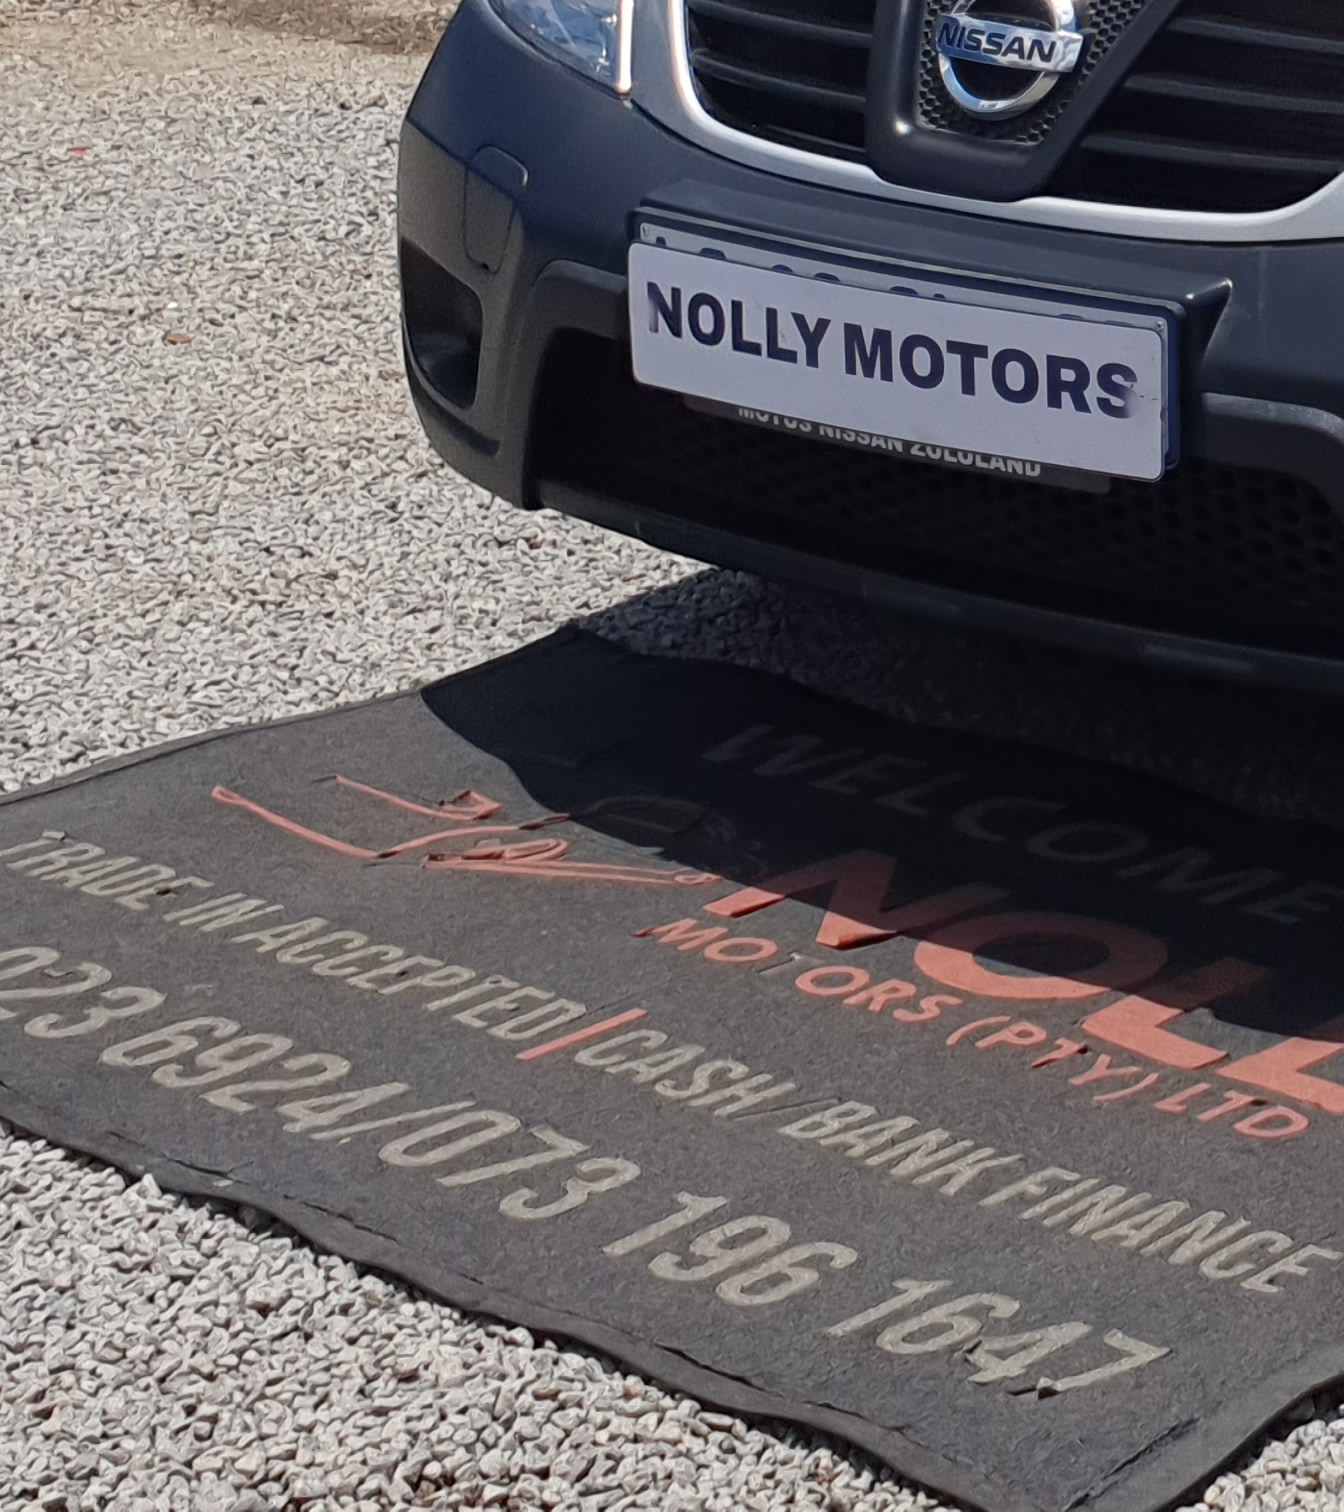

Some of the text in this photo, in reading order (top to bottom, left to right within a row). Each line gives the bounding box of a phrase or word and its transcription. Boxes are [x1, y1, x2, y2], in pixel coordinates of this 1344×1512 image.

[937, 22, 1057, 63] NISSAN
[646, 281, 1138, 420] NOLLY MOTORS
[163, 892, 285, 933] IN
[979, 1166, 1344, 1293] FINANCE
[633, 918, 963, 1023] MOTORS
[1153, 1082, 1310, 1139] LTD
[602, 1191, 859, 1306] 196
[824, 1277, 1172, 1398] 1647
